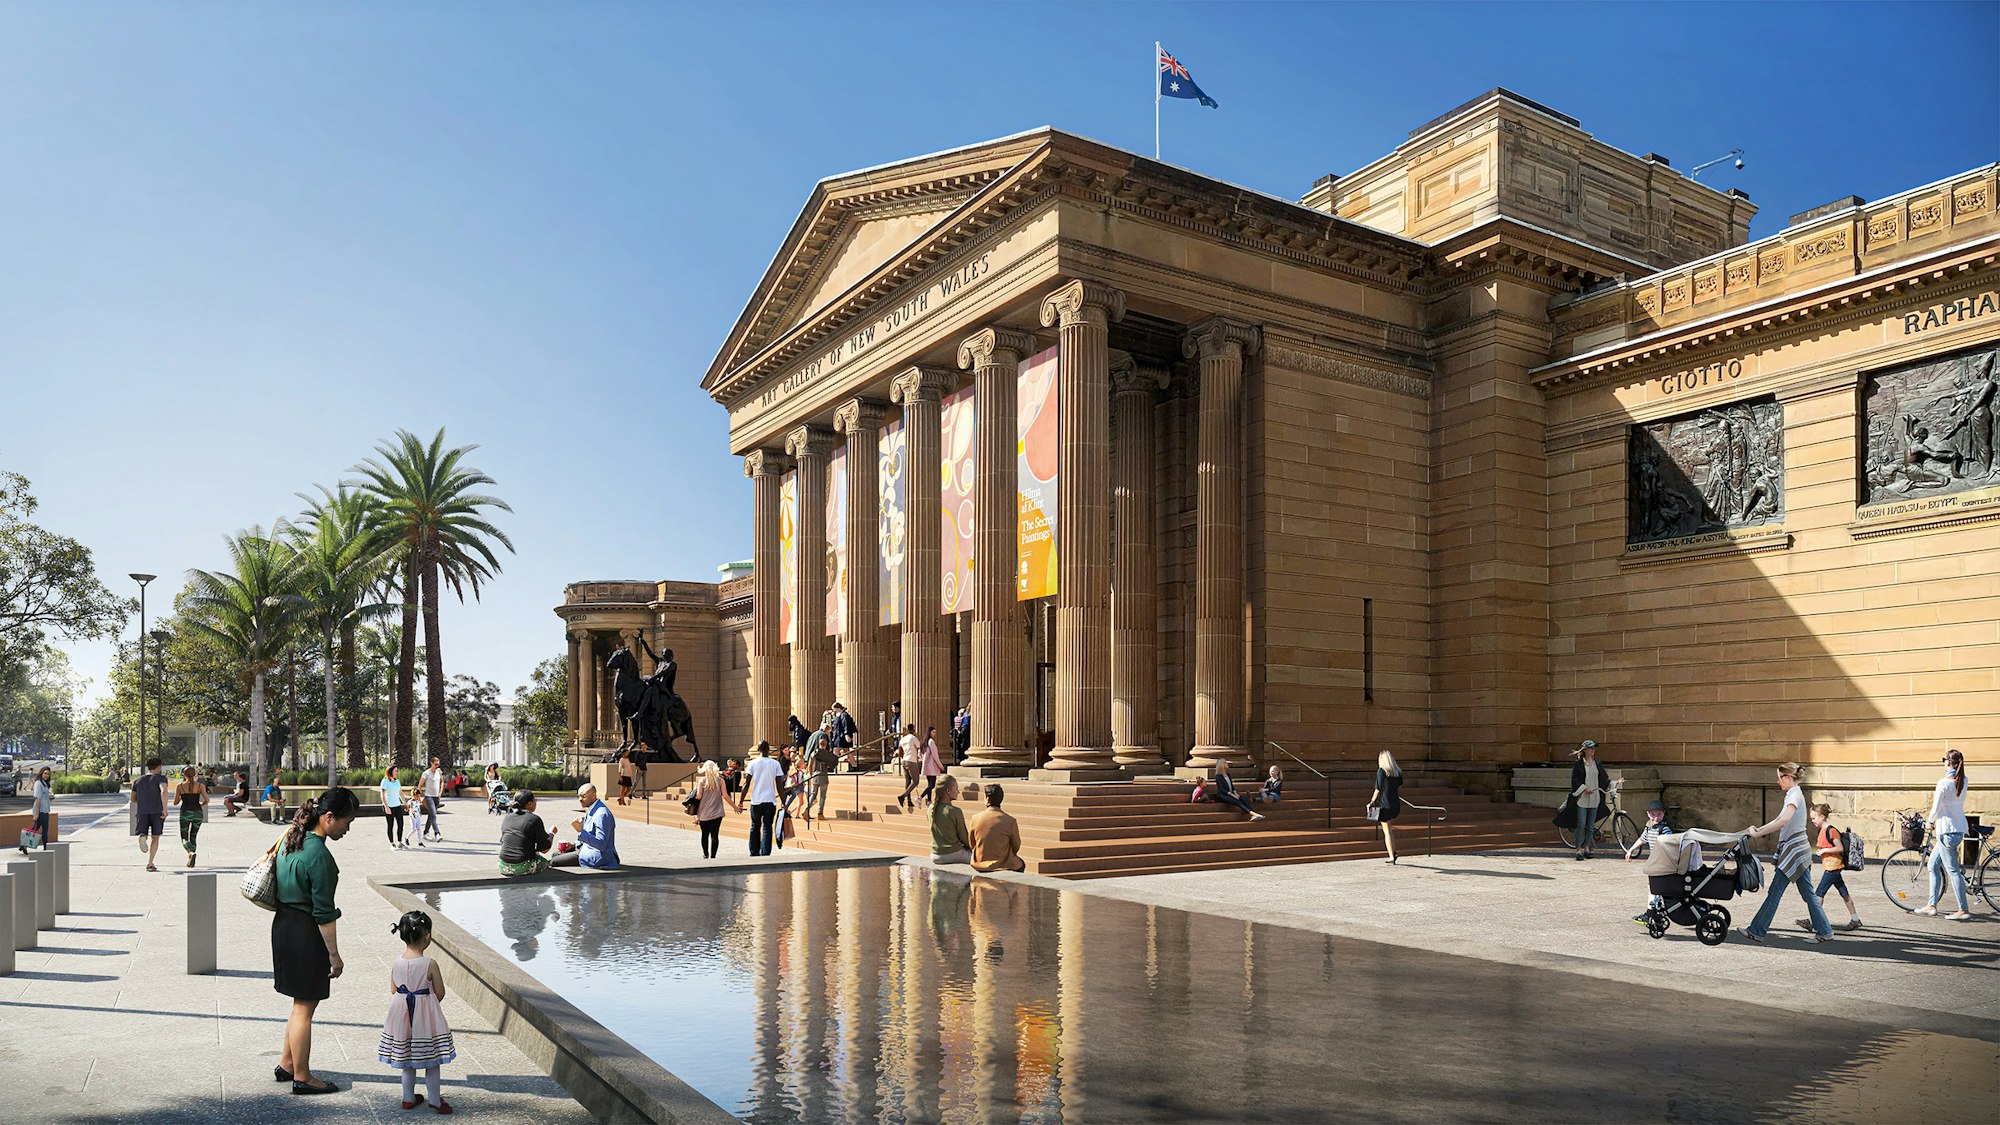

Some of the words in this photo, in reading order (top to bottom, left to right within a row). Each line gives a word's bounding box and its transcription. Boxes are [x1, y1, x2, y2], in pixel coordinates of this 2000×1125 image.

[1904, 293, 2000, 335] RAPHA
[762, 387, 778, 408] ART
[783, 356, 823, 394] GALLERY
[830, 346, 844, 365] OF
[851, 326, 875, 354] NEW
[886, 291, 929, 333] SOUTH
[940, 254, 989, 297] WALES
[1661, 360, 1742, 395] GIOTTO
[1021, 487, 1041, 501] Hilma
[1021, 500, 1028, 514] af
[1028, 498, 1044, 512] Klint
[1858, 510, 1885, 520] QUEEN
[1021, 520, 1034, 532] The
[1034, 515, 1055, 529] Secret
[1021, 529, 1051, 545] Paintings
